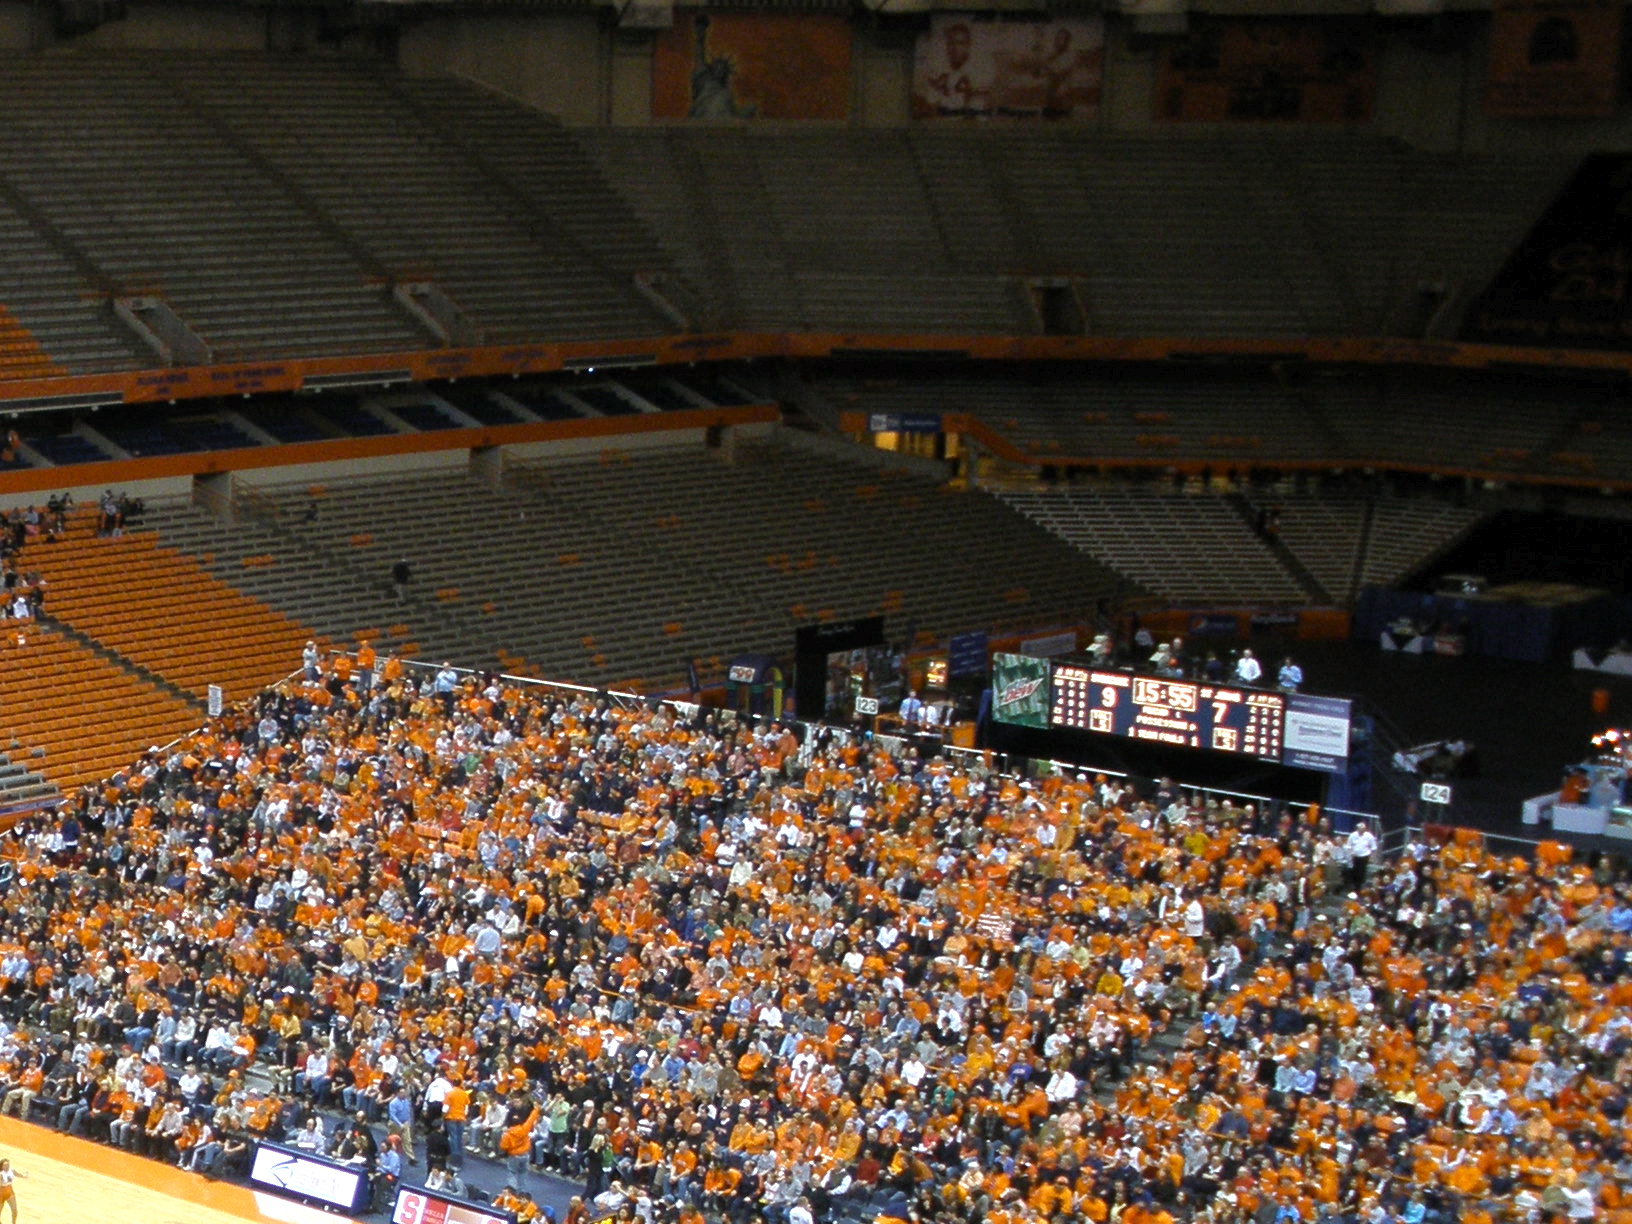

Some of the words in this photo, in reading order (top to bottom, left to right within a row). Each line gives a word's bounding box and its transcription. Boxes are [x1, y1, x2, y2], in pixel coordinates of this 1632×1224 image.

[1102, 687, 1115, 707] 9
[1136, 681, 1193, 708] 15:55
[856, 697, 877, 713] 123
[1212, 702, 1227, 723] 7
[1424, 785, 1449, 802] 124
[400, 1194, 421, 1224] S
